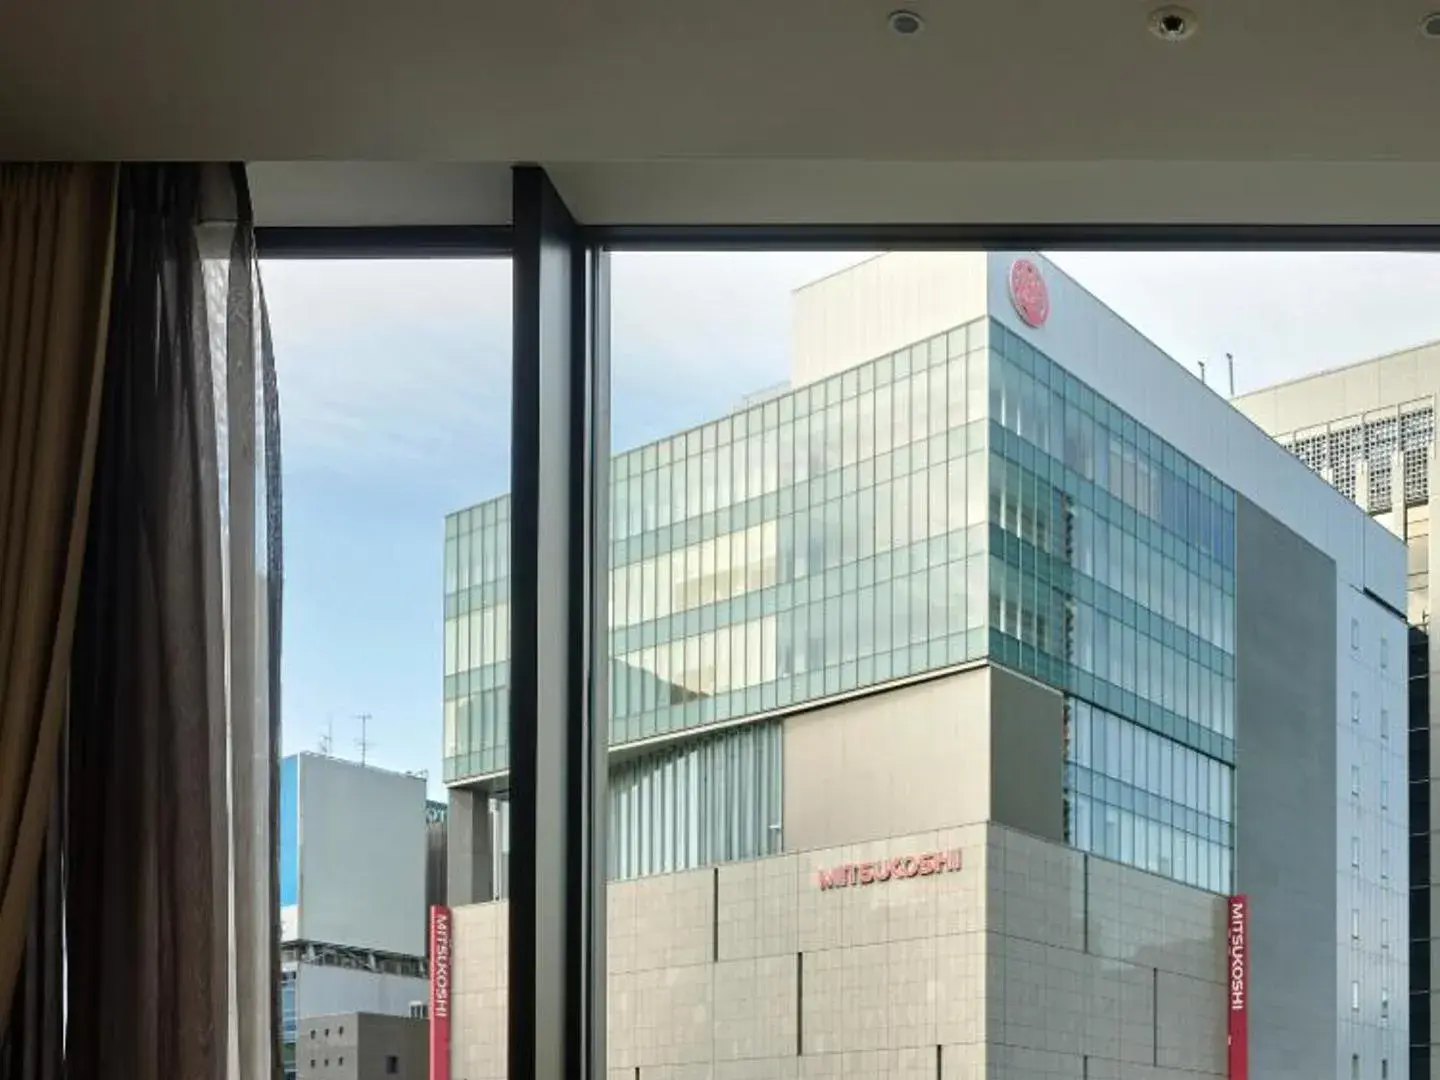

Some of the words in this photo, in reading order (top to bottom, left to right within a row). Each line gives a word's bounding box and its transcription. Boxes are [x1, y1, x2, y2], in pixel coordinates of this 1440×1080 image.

[818, 849, 963, 891] MITSUKOSHI
[436, 914, 449, 1018] MITSUKOSHI
[1231, 902, 1244, 1011] MITSUKOSHI
